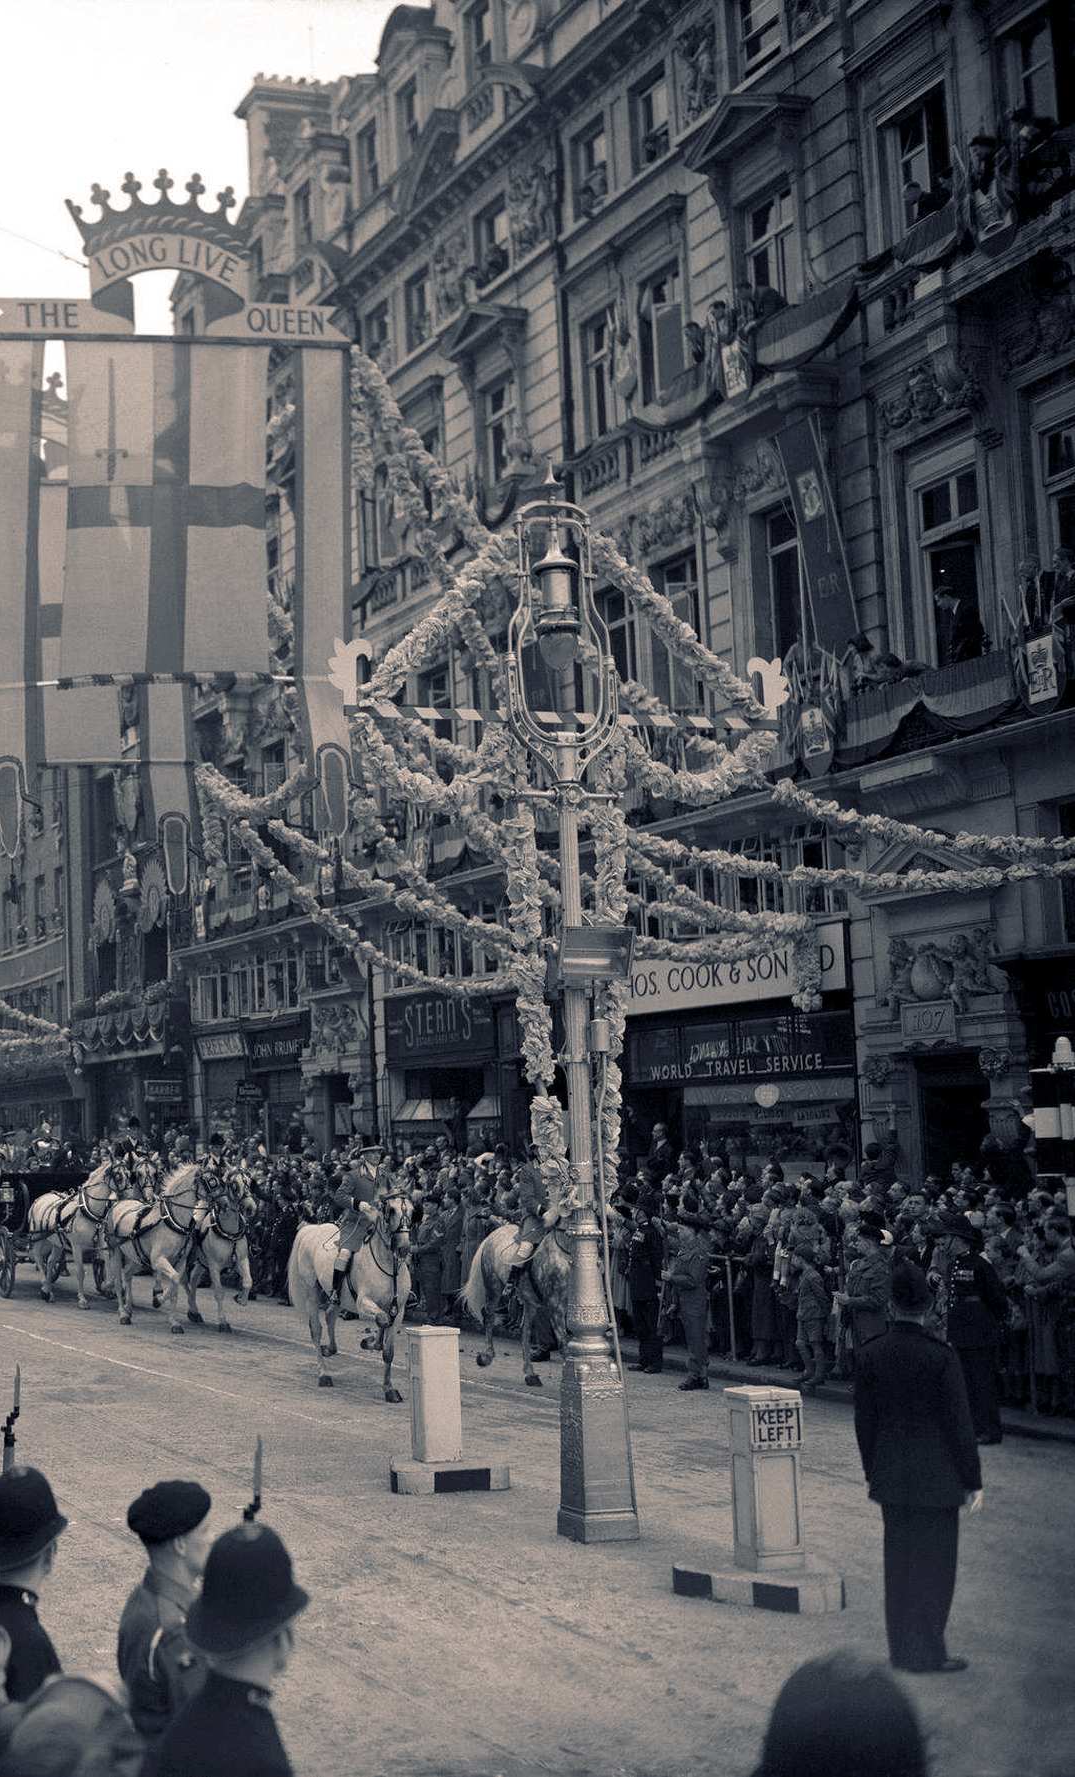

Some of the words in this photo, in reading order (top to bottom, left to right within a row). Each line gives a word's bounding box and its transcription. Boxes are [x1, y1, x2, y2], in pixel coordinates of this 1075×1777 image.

[95, 237, 167, 279] LONG
[178, 239, 239, 283] LIVE
[17, 302, 79, 329] THE
[247, 307, 324, 336] QUEEN
[668, 965, 723, 992] COOK
[730, 962, 741, 984] &
[747, 951, 788, 982] SON
[650, 1064, 692, 1081] WORLD
[706, 1058, 754, 1077] TRAVEL
[765, 1053, 821, 1073] SERVICE
[757, 1408, 793, 1425] KEEP
[758, 1426, 794, 1442] LEFT
